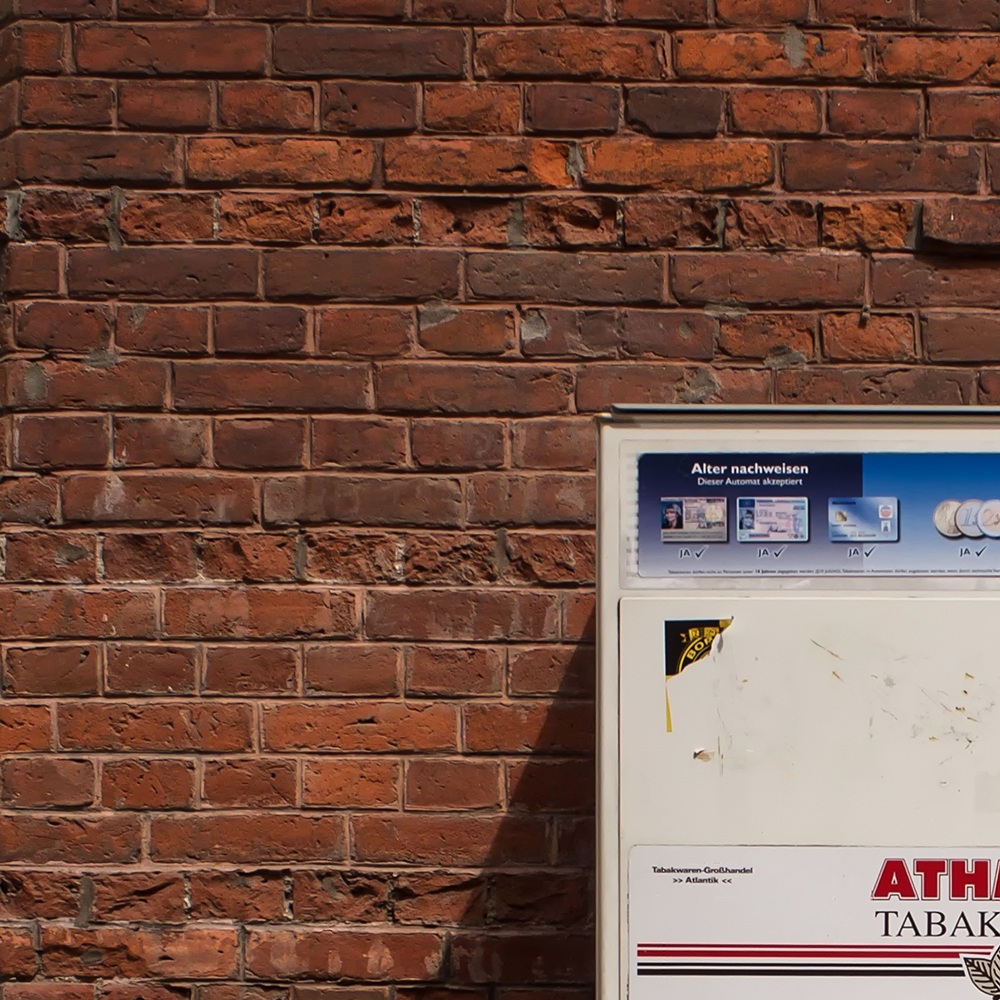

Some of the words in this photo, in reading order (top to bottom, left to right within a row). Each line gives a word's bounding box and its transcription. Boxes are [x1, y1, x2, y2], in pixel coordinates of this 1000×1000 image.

[691, 463, 727, 474] Alter
[731, 463, 809, 474] nachweisen
[697, 477, 723, 485] Dieser
[725, 477, 760, 485] Automat
[762, 477, 803, 487] akzeptiert
[680, 549, 690, 558] JA
[758, 548, 769, 558] JA
[848, 548, 859, 557] JA
[960, 548, 971, 557] JA
[652, 866, 754, 874] Tabakwaren-Großhandel
[685, 876, 719, 884] Atlantik
